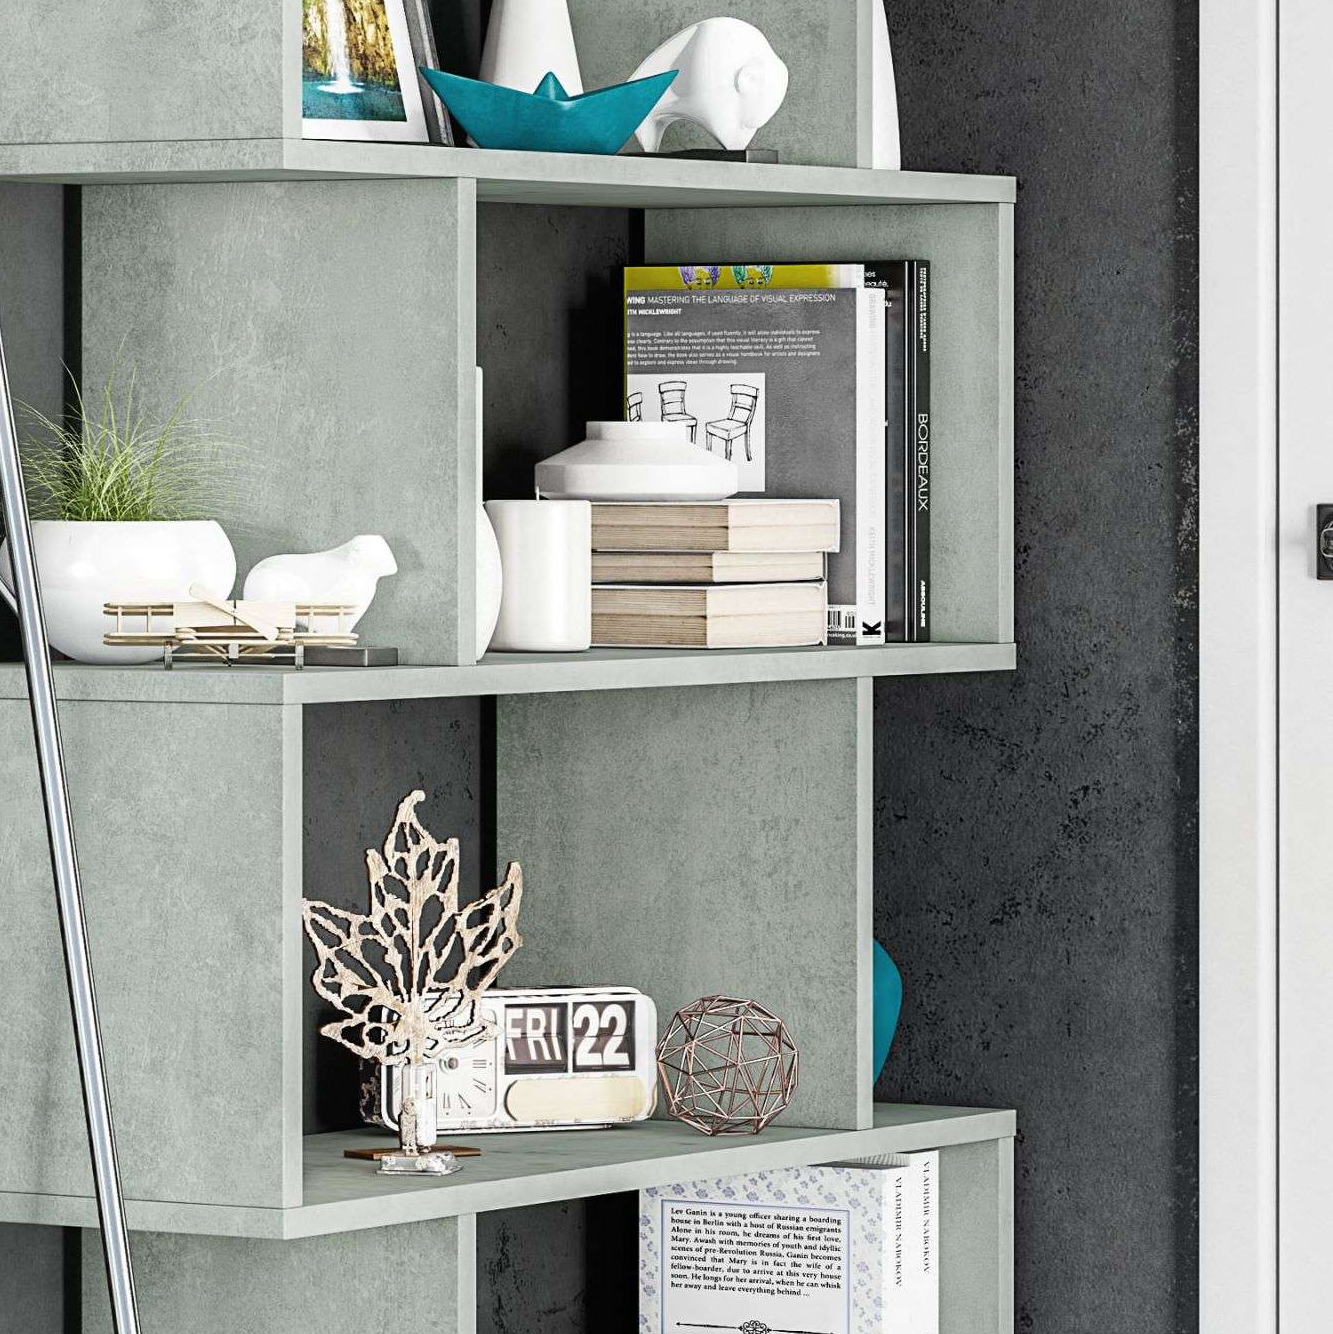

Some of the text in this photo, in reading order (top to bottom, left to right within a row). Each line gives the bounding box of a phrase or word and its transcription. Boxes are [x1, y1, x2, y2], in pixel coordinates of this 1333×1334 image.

[647, 295, 689, 304] MASTERING
[691, 295, 705, 303] THE
[707, 295, 747, 303] LANGUAGE
[749, 294, 759, 302] OF
[761, 294, 787, 302] VISUAL
[789, 294, 835, 302] EXPRESSION
[918, 413, 928, 511] BORDEAUX
[506, 1007, 562, 1061] FRI
[574, 1004, 630, 1066] 22
[670, 1207, 683, 1215] Lev
[685, 1208, 707, 1216] Ganin
[724, 1212, 746, 1220] young
[748, 1211, 770, 1220] officer
[773, 1213, 799, 1223] sharing
[808, 1215, 841, 1226] boarding
[670, 1216, 691, 1224] house
[703, 1218, 723, 1226] Berlin
[726, 1219, 741, 1227] with
[776, 1222, 803, 1231] Russian
[671, 1225, 691, 1233] Alone
[704, 1227, 715, 1235] his
[753, 1230, 779, 1238] dreams
[793, 1232, 803, 1240] his
[807, 1233, 820, 1241] first
[693, 1236, 716, 1244] Awash
[718, 1237, 733, 1245] with
[735, 1238, 770, 1247] memories
[781, 1241, 801, 1251] youth
[803, 1242, 817, 1250] and
[819, 1243, 840, 1253] idyllic
[670, 1253, 706, 1262] convinced
[710, 1255, 724, 1263] that
[729, 1256, 747, 1266] Mary
[773, 1259, 785, 1267] fact
[790, 1260, 802, 1268] the
[806, 1261, 821, 1269] wife
[704, 1246, 756, 1258] pre-Revolution
[786, 1251, 808, 1259] Ganin
[810, 1252, 841, 1261] becomes
[726, 1265, 739, 1273] due
[752, 1267, 773, 1275] arrive
[786, 1269, 799, 1277] this
[802, 1272, 817, 1280] very
[820, 1271, 841, 1279] house
[670, 1280, 801, 1296] her away and leave everything behind
[703, 1273, 721, 1283] longs
[723, 1274, 733, 1282] for
[735, 1275, 746, 1283] her
[776, 1278, 794, 1286] when
[820, 1281, 840, 1289] whisk
